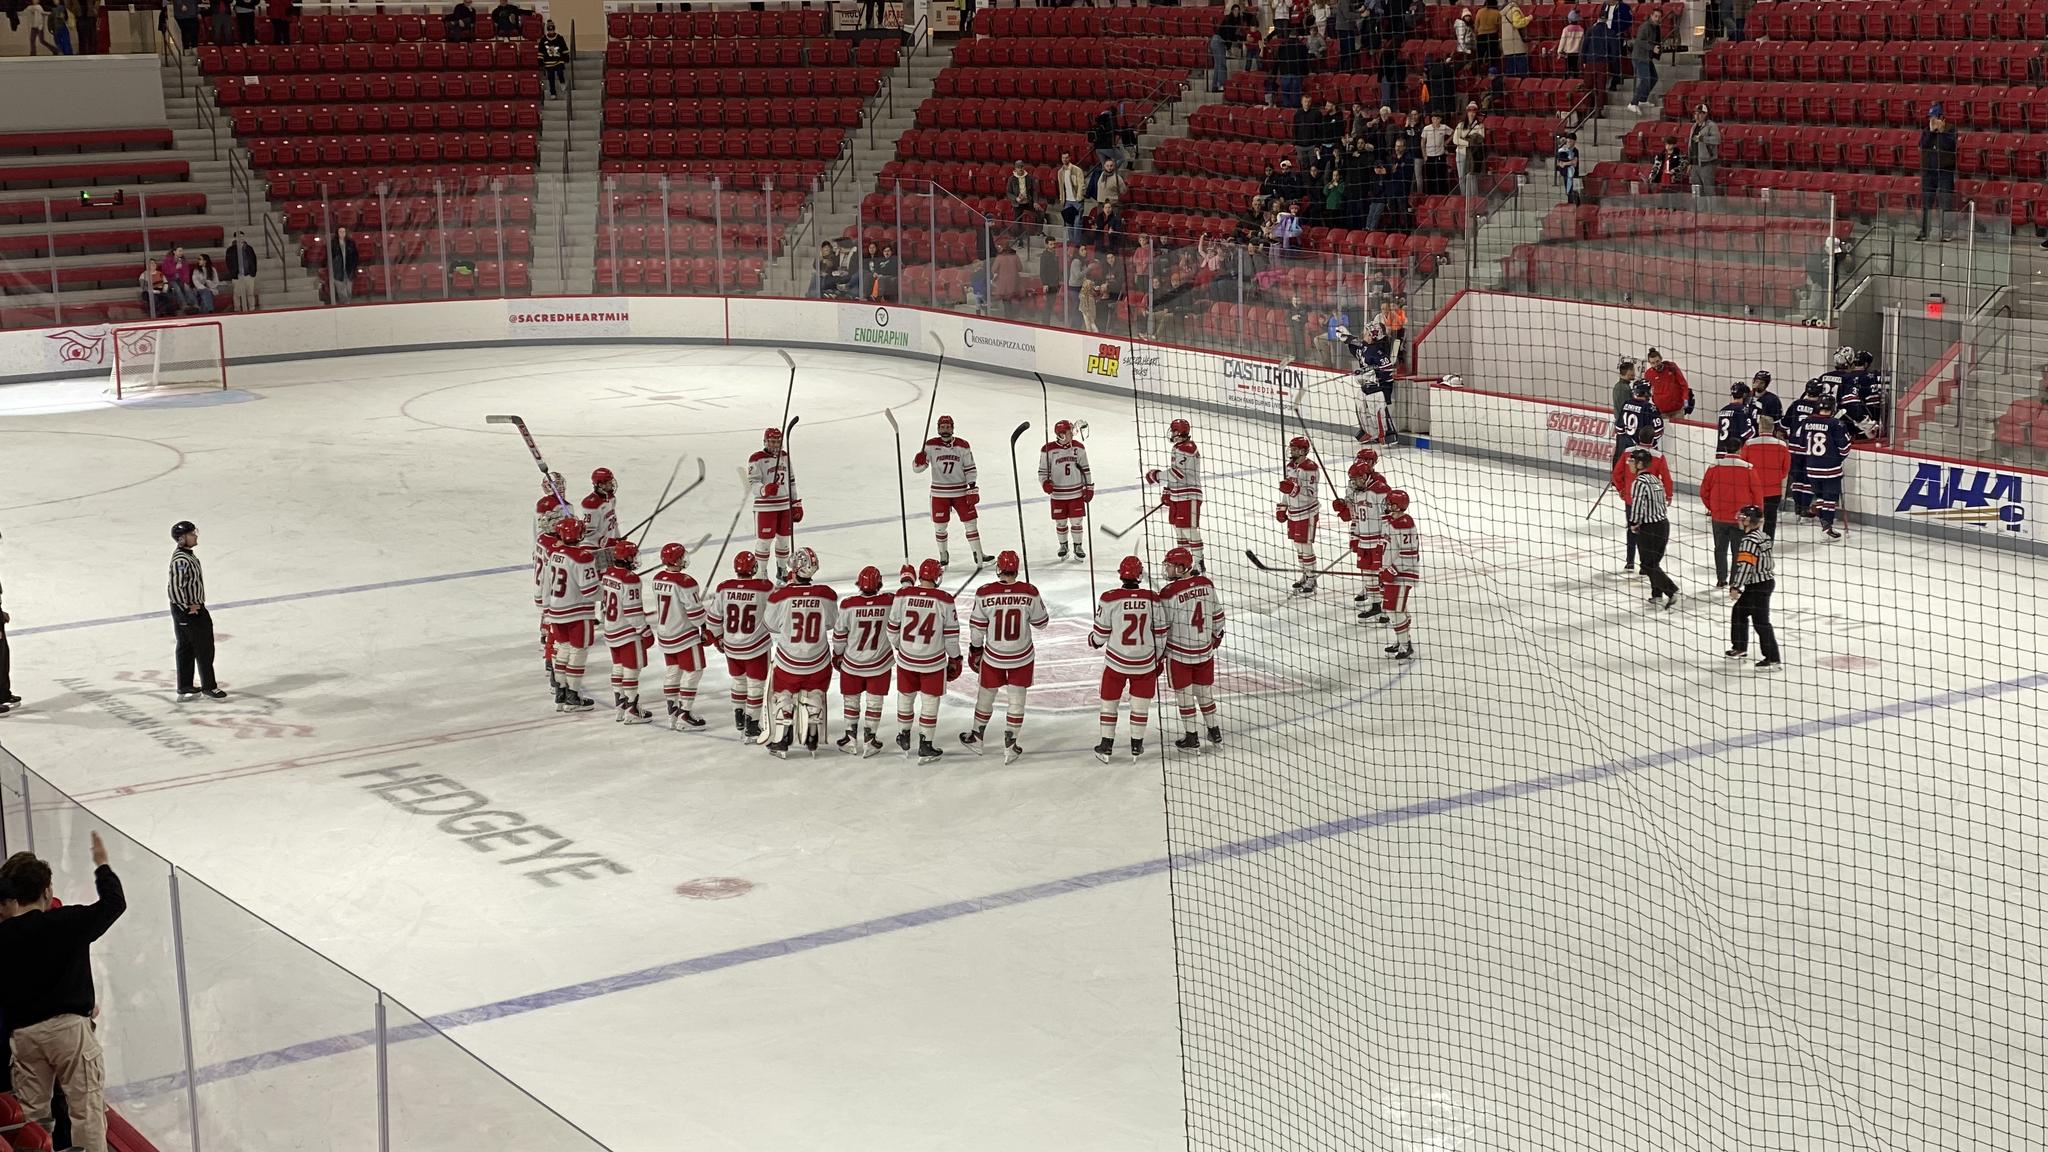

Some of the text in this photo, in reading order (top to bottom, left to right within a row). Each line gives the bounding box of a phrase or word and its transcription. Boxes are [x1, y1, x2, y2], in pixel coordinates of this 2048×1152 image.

[509, 313, 629, 323] @SACREDHEARTMIH
[854, 328, 909, 346] ENDURAPHIN
[1087, 355, 1119, 377] PLR
[1251, 385, 1275, 395] MEDIA
[1548, 411, 1609, 438] SACRED
[1623, 412, 1639, 436] 19
[1652, 418, 1662, 428] 19
[1719, 418, 1730, 441] 3
[1807, 431, 1827, 456] 18
[943, 462, 954, 474] 77
[1065, 464, 1071, 476] 6
[584, 567, 596, 580] 23
[727, 592, 755, 601] TARDIF
[791, 599, 820, 608] SPICER
[907, 597, 934, 608] RUBIN
[1123, 600, 1146, 610] ELLIS
[1178, 587, 1210, 603] DRISCOLL
[726, 603, 757, 634] 86
[855, 608, 885, 618] HUARD
[1191, 601, 1205, 633] 4
[790, 612, 822, 643] 30
[902, 610, 936, 645] 24
[993, 608, 1022, 641] 10
[1121, 613, 1148, 645] 21
[857, 620, 883, 651] 71
[340, 762, 634, 888] HEDGEYE
